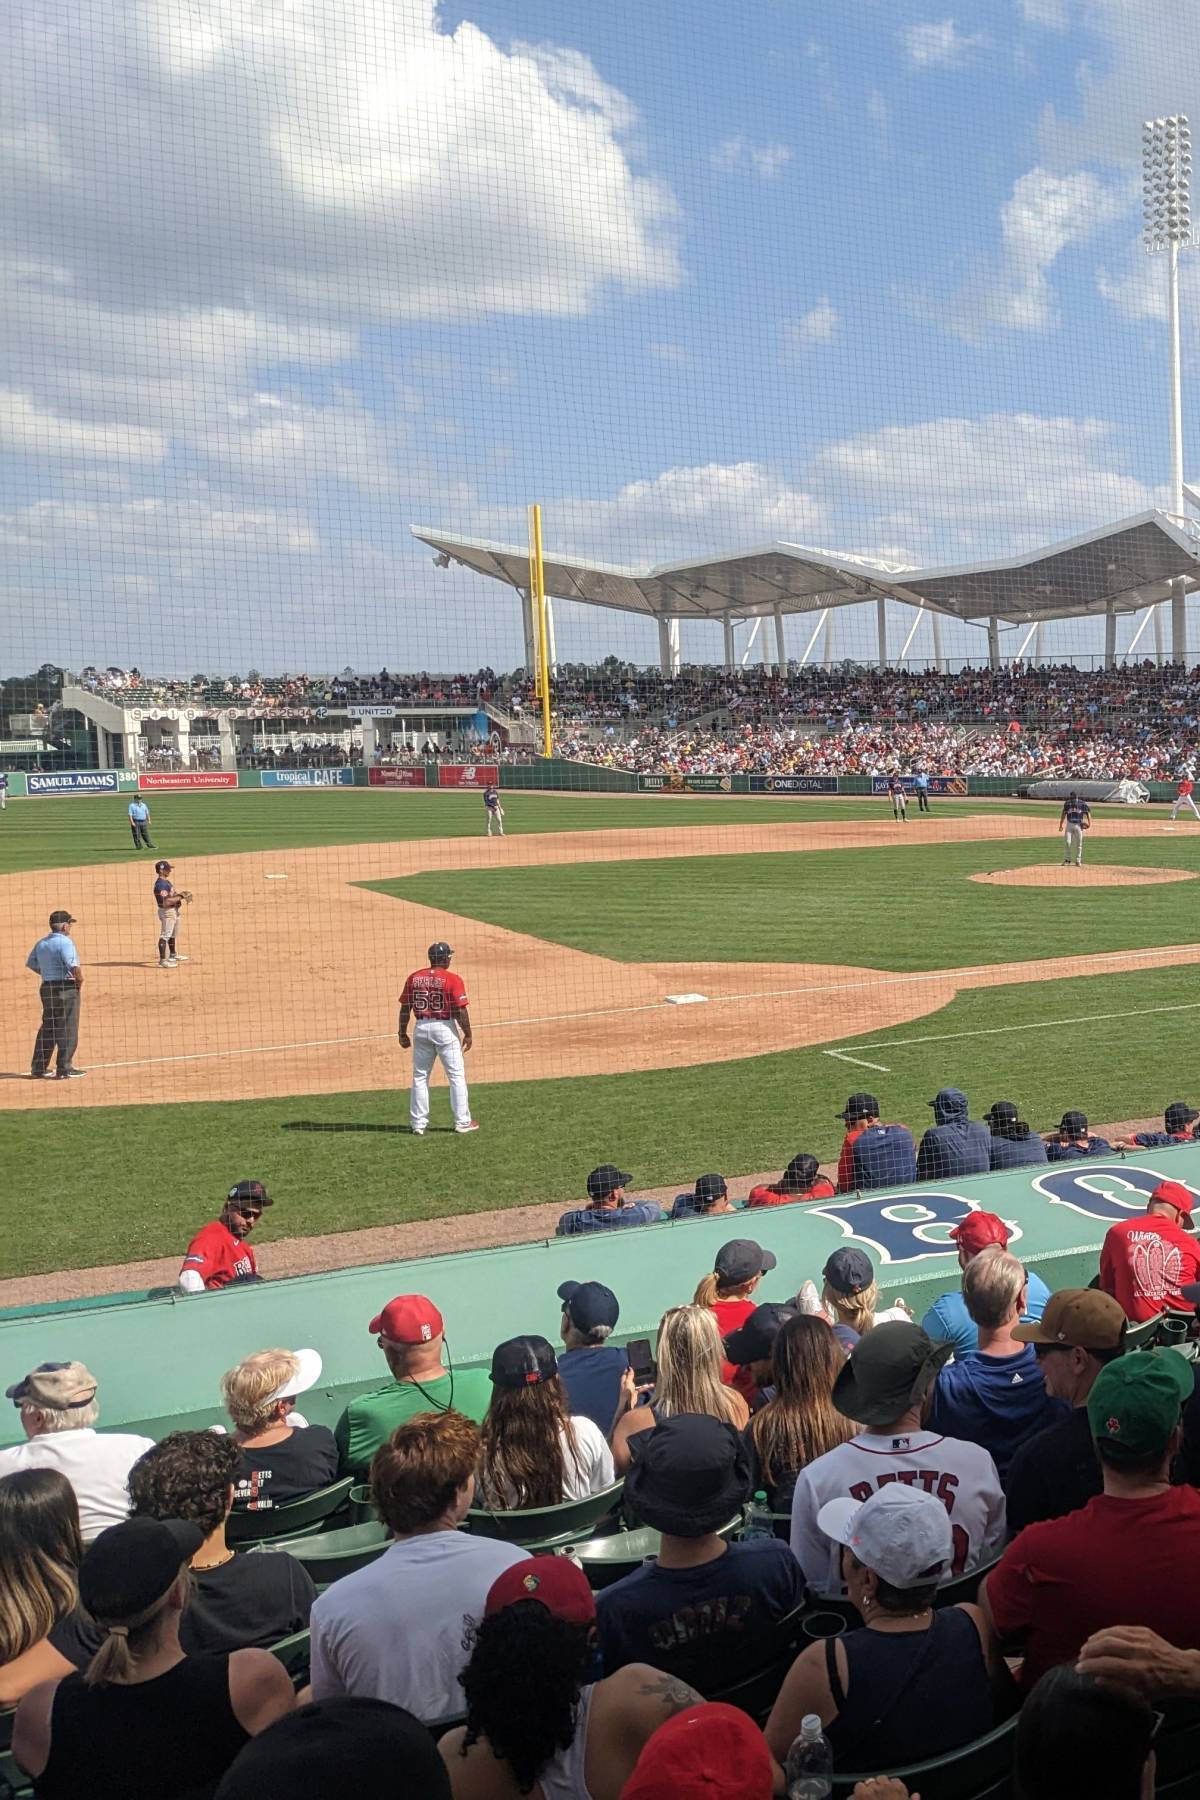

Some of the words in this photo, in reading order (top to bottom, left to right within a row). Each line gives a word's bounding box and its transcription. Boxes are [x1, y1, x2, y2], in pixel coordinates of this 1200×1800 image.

[30, 777, 76, 789] SAMUEL
[76, 774, 115, 787] ADAMS
[118, 772, 138, 782] 380
[146, 777, 191, 785] Northeastern
[193, 776, 230, 784] University
[276, 771, 311, 782] tropical
[314, 769, 343, 785] CAFE
[1126, 1230, 1162, 1243] Winter
